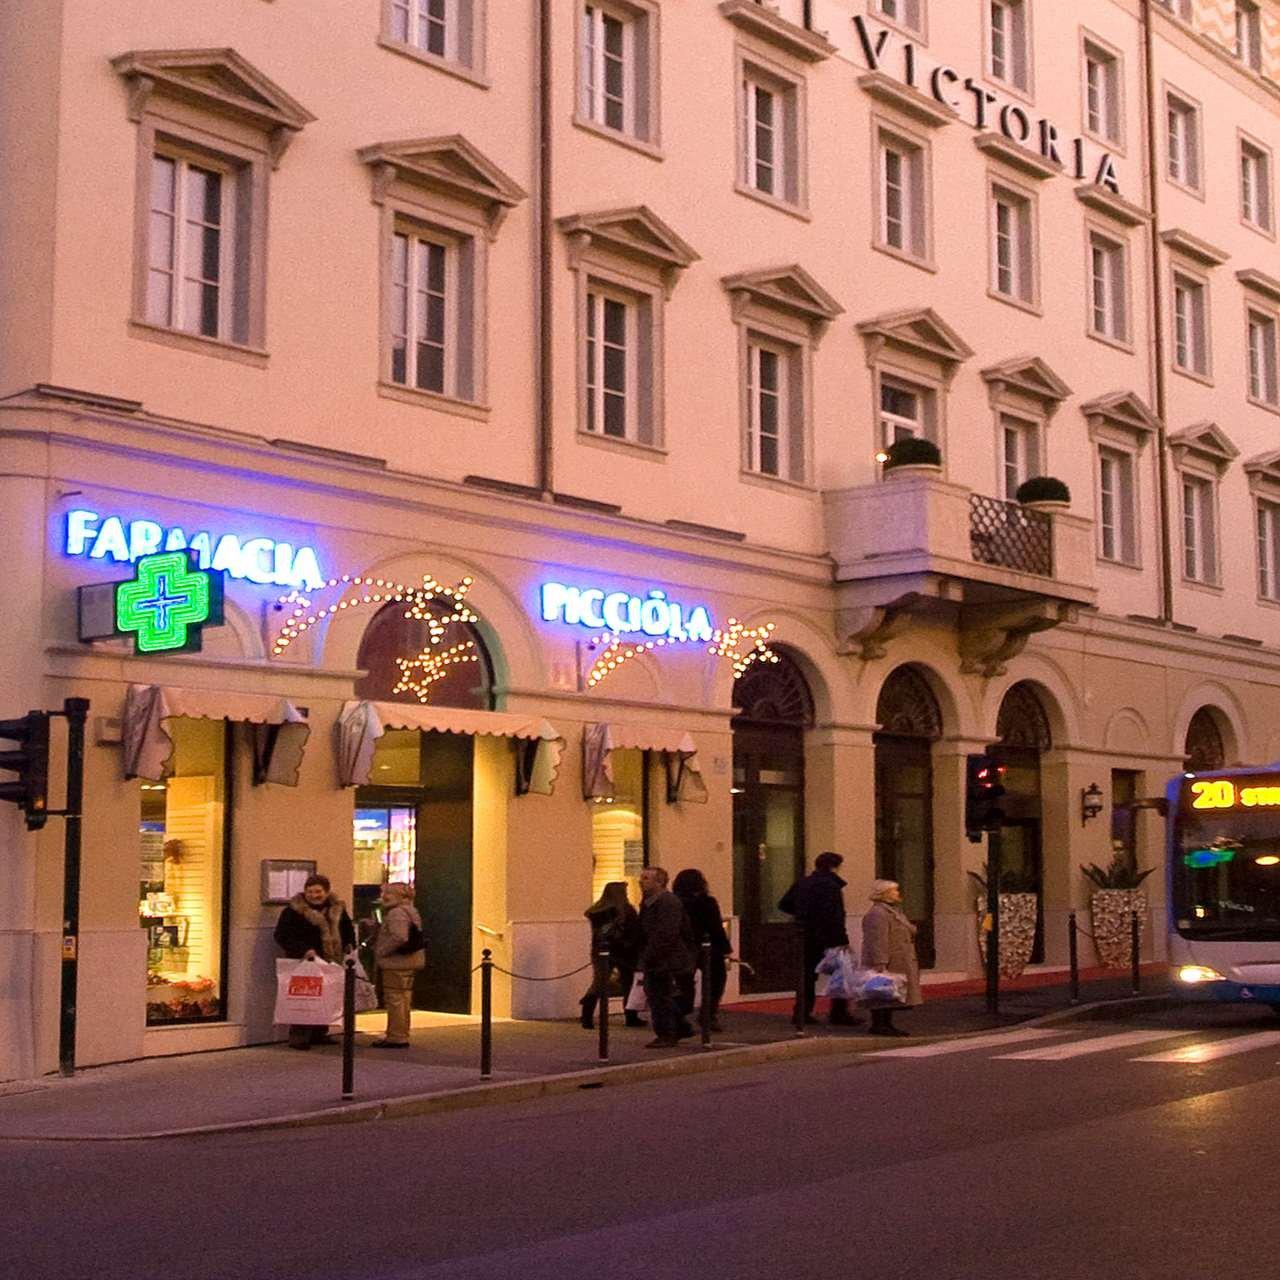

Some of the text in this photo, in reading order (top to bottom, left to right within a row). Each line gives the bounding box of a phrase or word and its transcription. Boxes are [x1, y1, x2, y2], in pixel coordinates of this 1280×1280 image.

[852, 15, 1122, 195] VICTORIA
[67, 509, 324, 593] FARMACIA
[1191, 780, 1235, 809] 20
